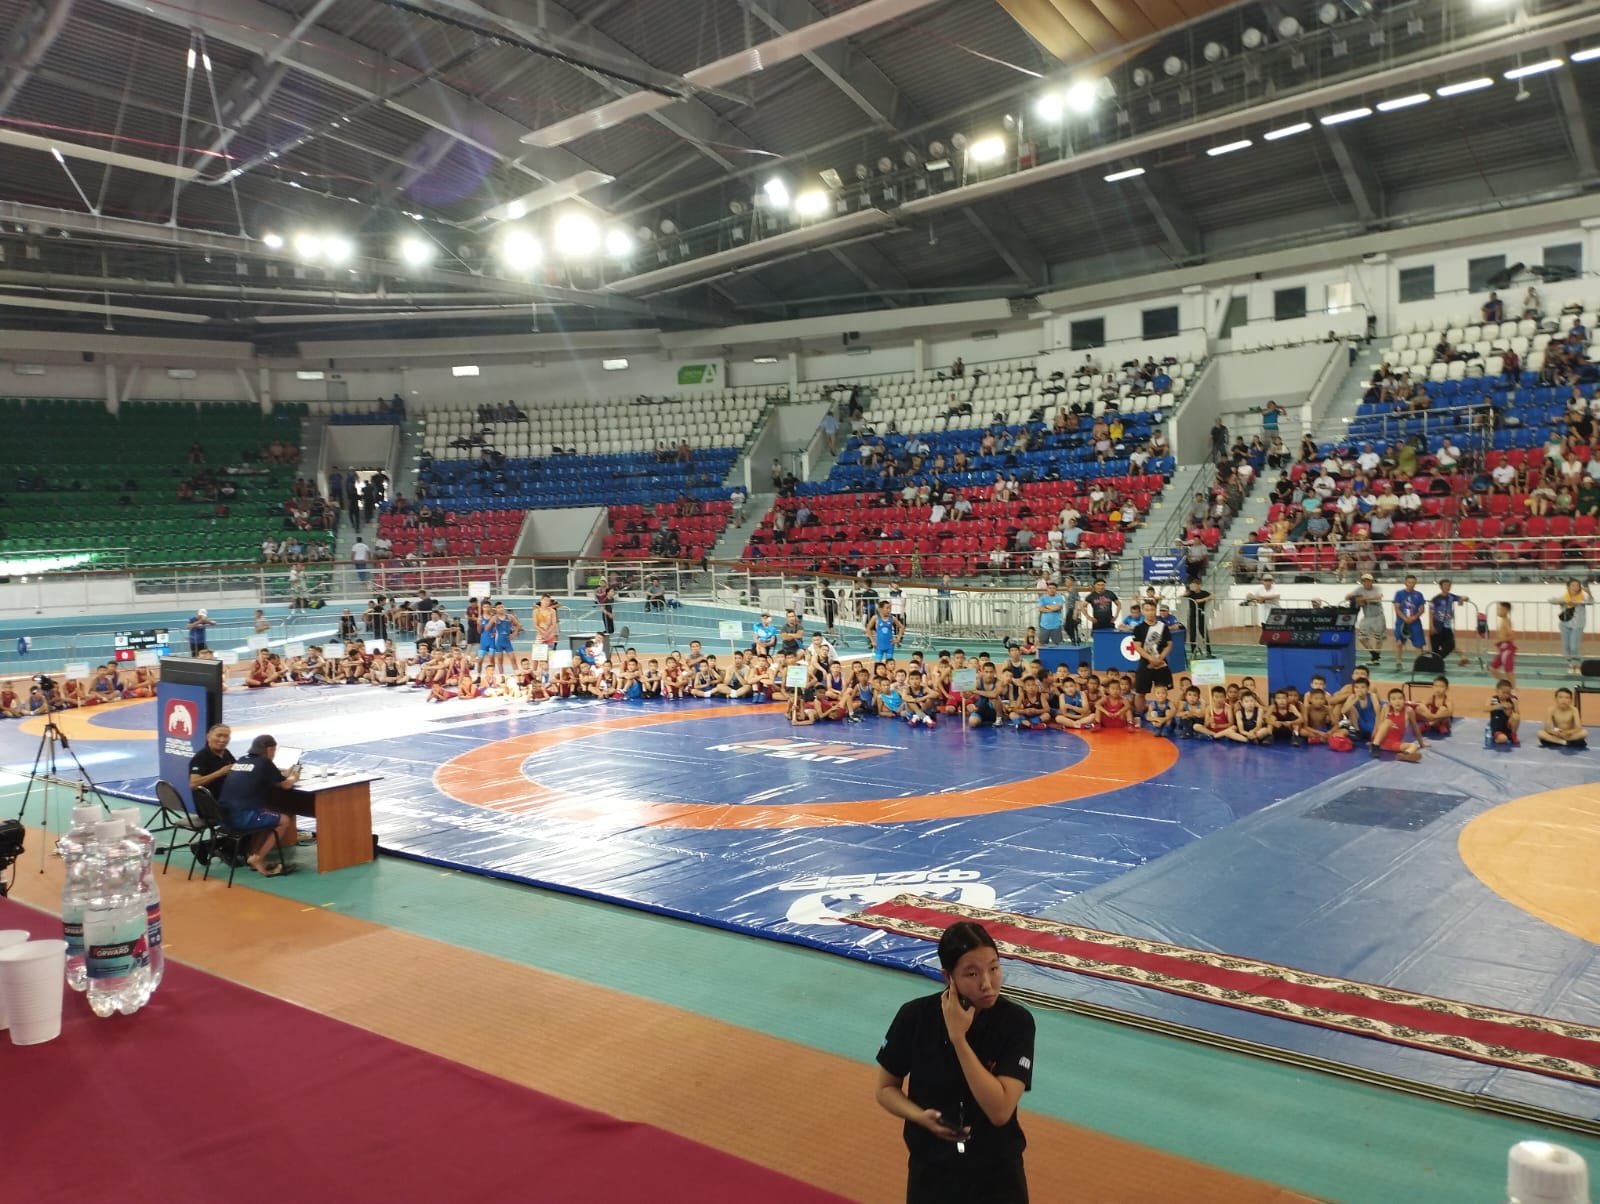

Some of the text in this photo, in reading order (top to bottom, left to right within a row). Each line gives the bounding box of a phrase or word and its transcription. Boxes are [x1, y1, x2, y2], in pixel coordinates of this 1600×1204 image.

[1272, 632, 1340, 642] 0 3:57 0
